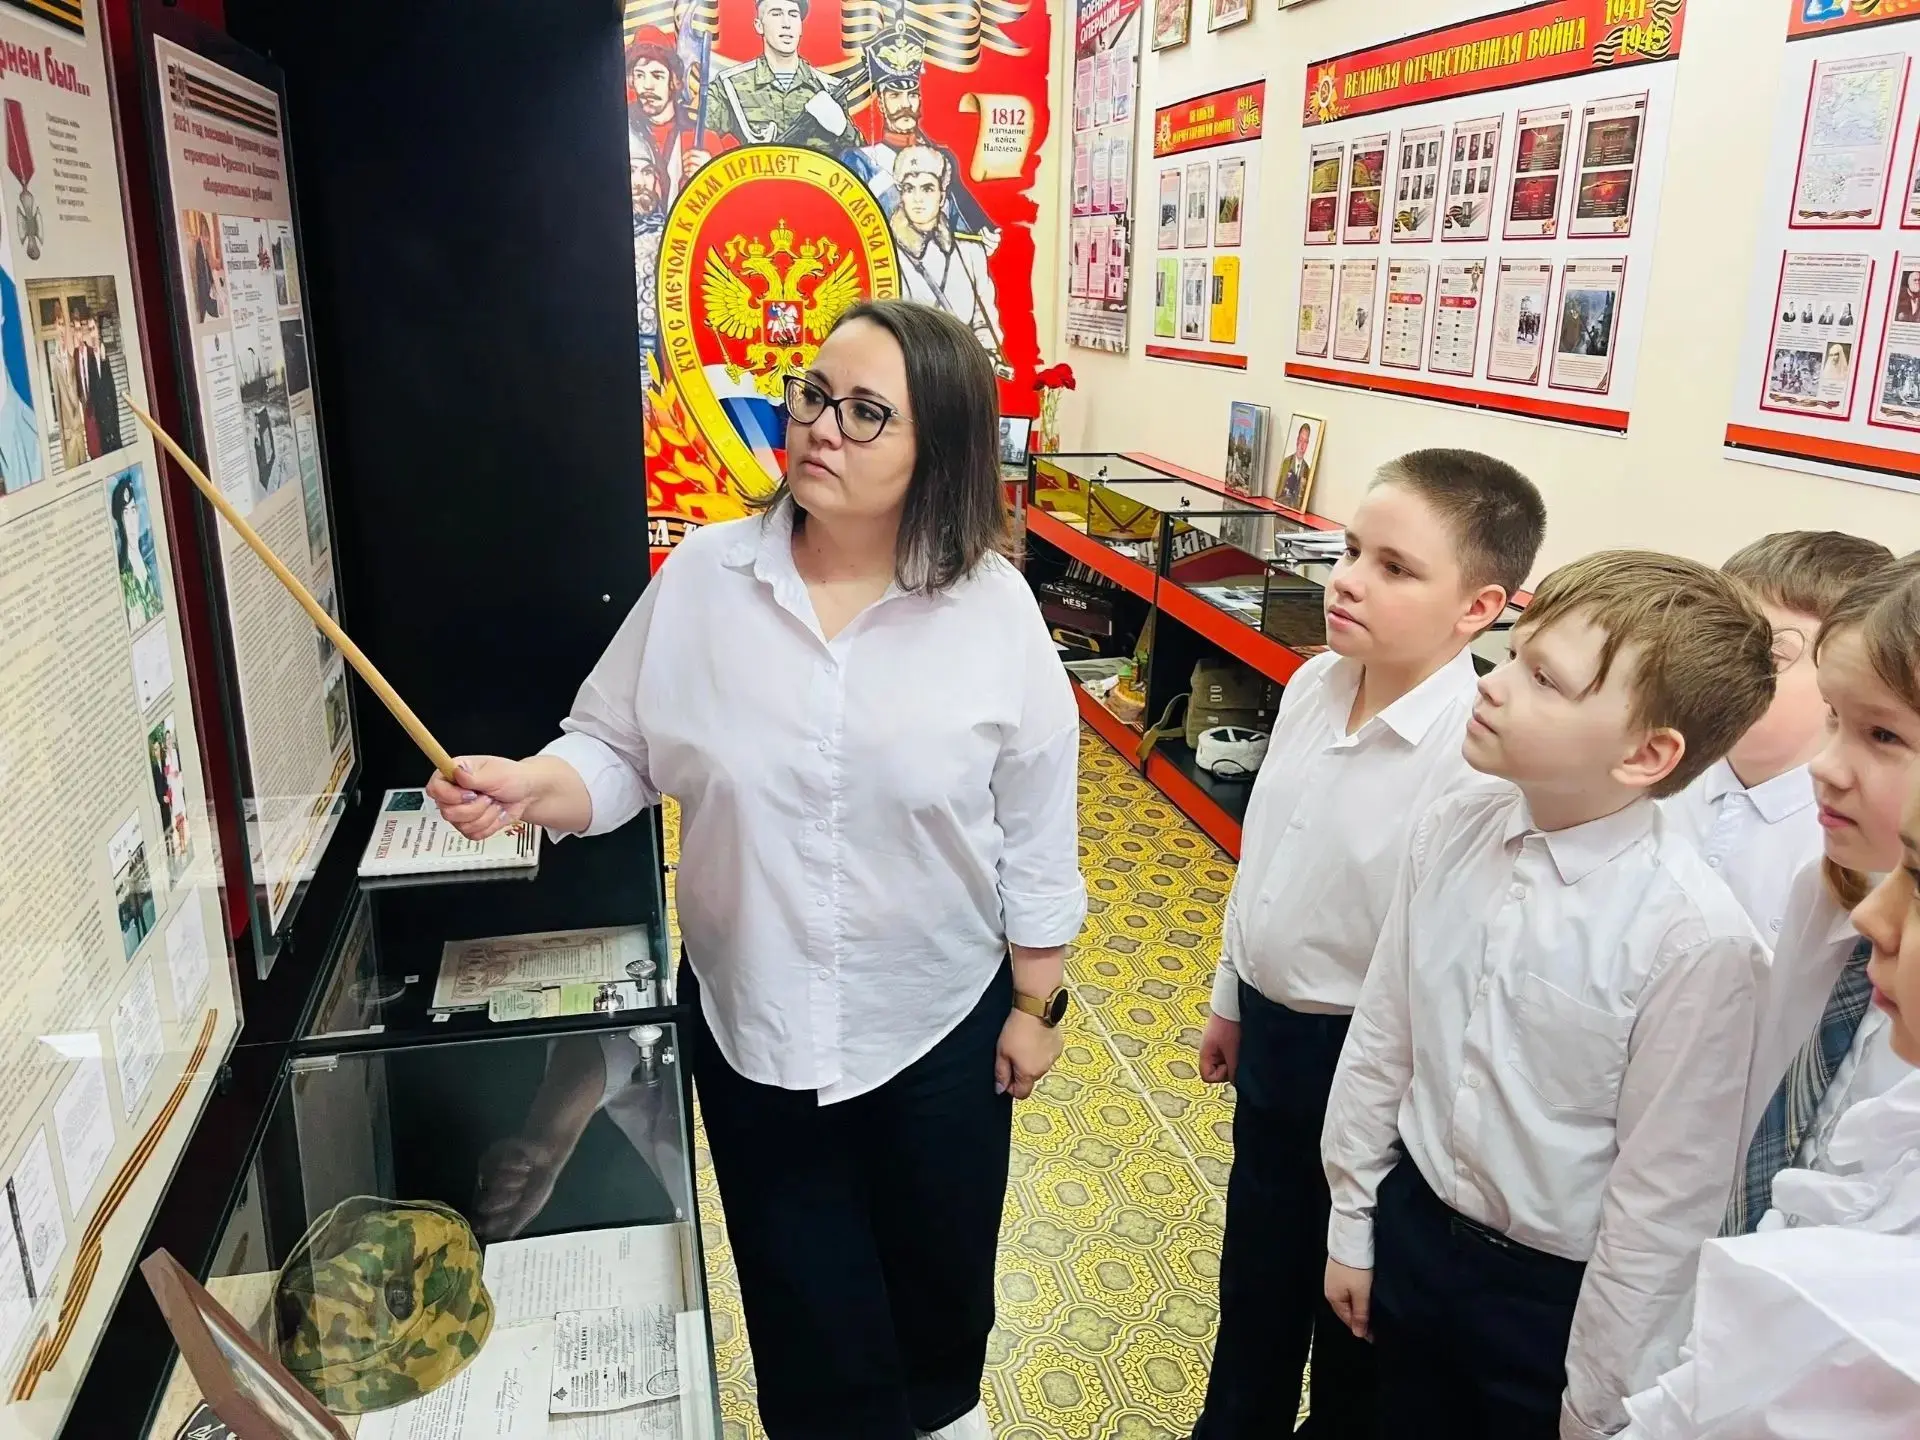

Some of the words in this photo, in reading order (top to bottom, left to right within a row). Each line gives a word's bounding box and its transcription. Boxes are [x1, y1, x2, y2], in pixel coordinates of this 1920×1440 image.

[1620, 17, 1665, 56] 1945
[44, 46, 91, 97] был...
[1343, 60, 1401, 99] ВЕЛИКАЯ
[1404, 31, 1523, 86] ОТЕЧЕСТВЕННАЯ
[1525, 16, 1585, 61] ВОЙНА
[992, 108, 1026, 125] 1812
[722, 154, 800, 182] ПРИДЕТ
[689, 175, 724, 217] НАМ
[828, 172, 853, 197] ОТ
[677, 216, 693, 233] К
[850, 198, 883, 253] МЕЧА
[665, 238, 688, 313] МЕЧОМ
[873, 256, 889, 271] И
[668, 319, 686, 331] С
[672, 336, 697, 373] КТО
[1062, 596, 1087, 610] HESS
